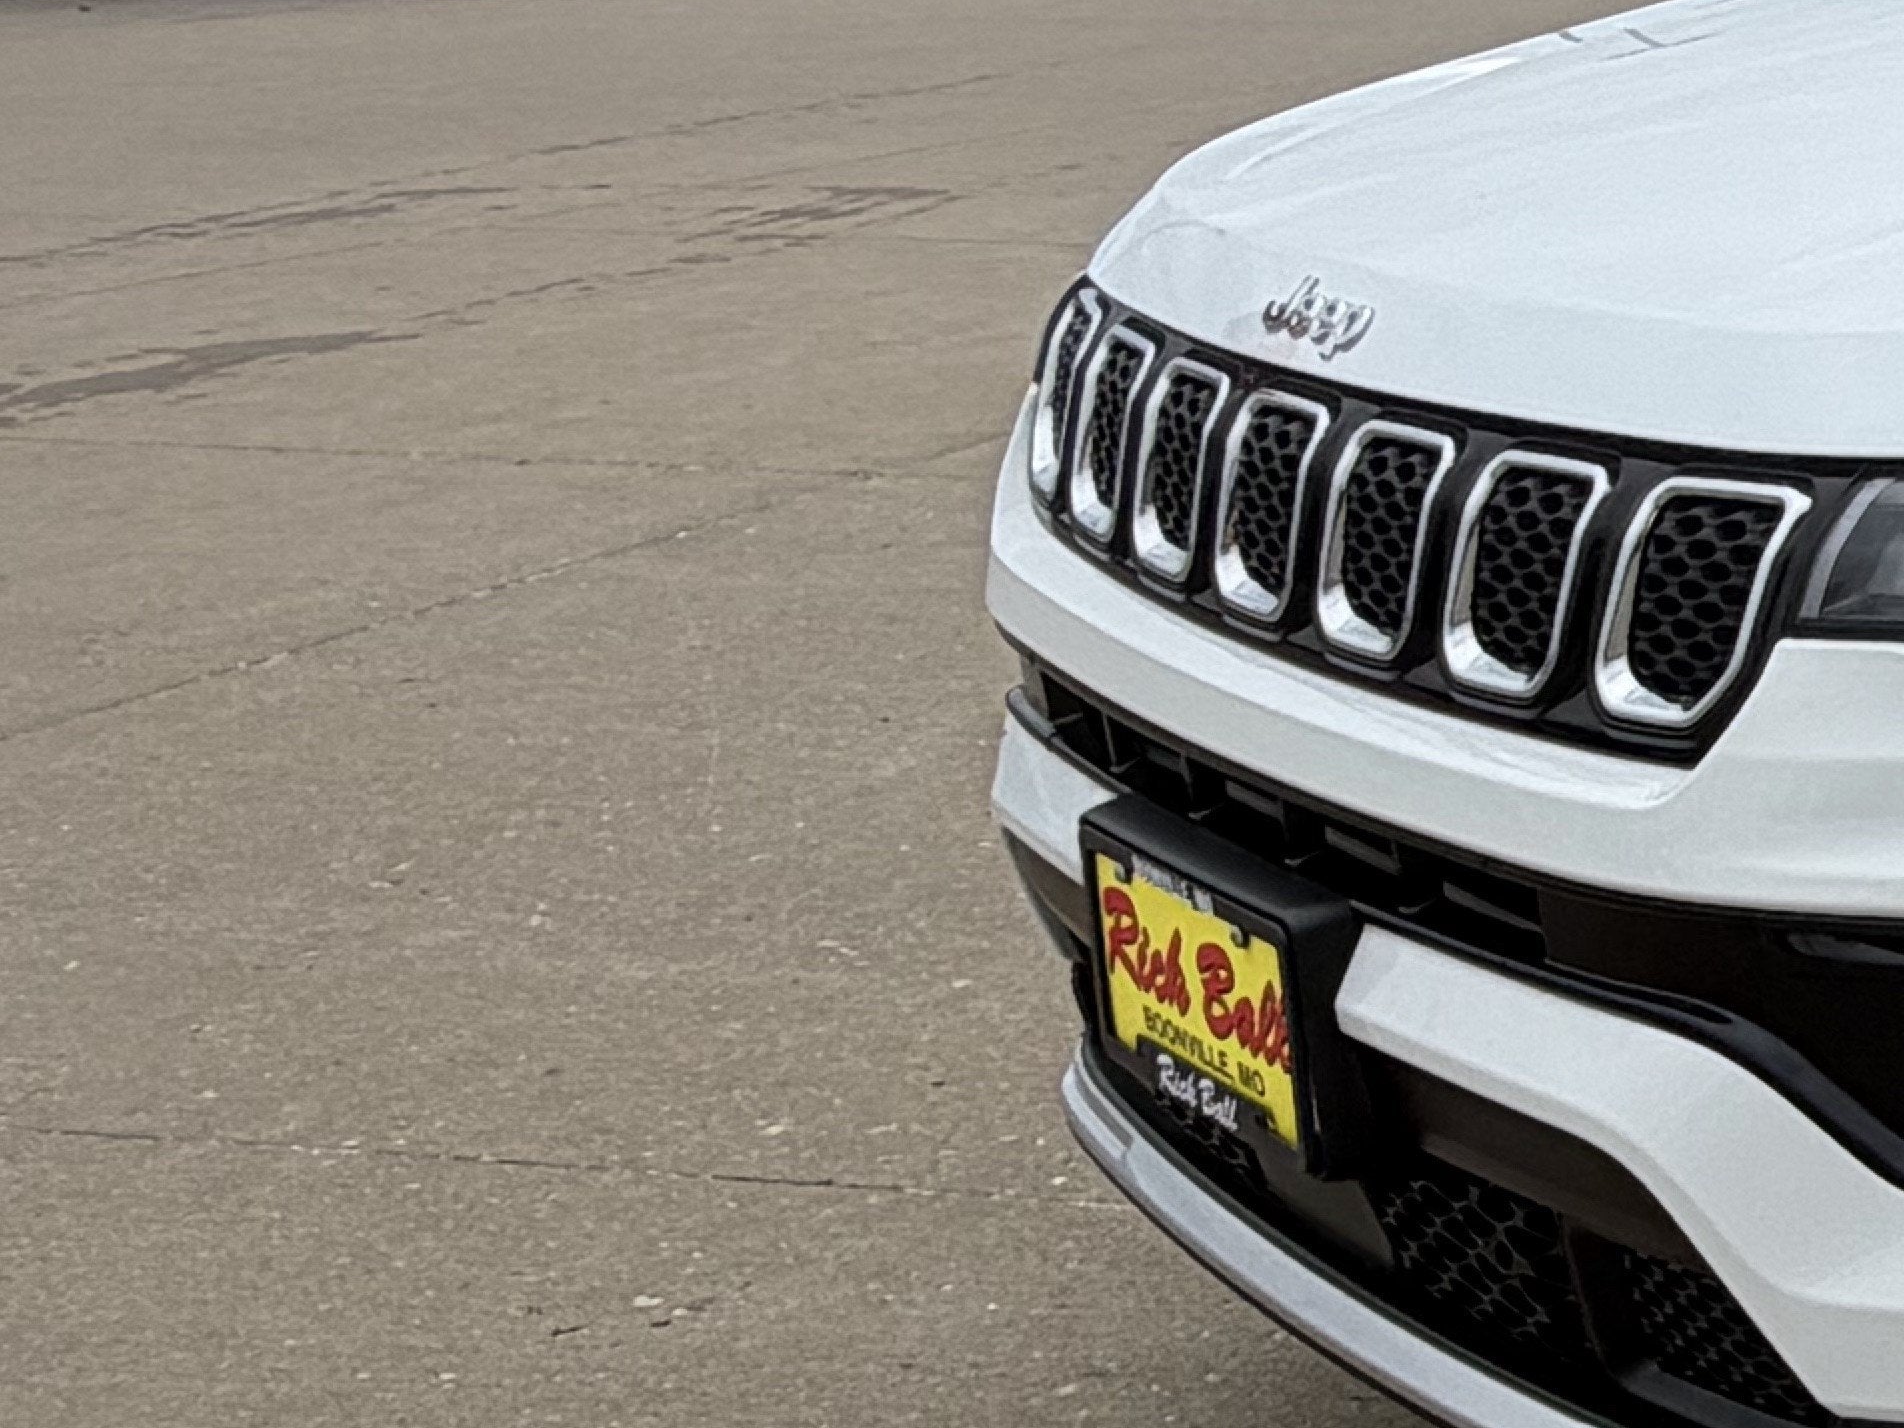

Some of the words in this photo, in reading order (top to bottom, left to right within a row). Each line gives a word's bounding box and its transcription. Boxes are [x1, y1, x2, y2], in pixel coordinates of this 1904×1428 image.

[1262, 274, 1376, 362] Jeep
[1103, 886, 1191, 1017] Rick
[1196, 942, 1294, 1075] Ball
